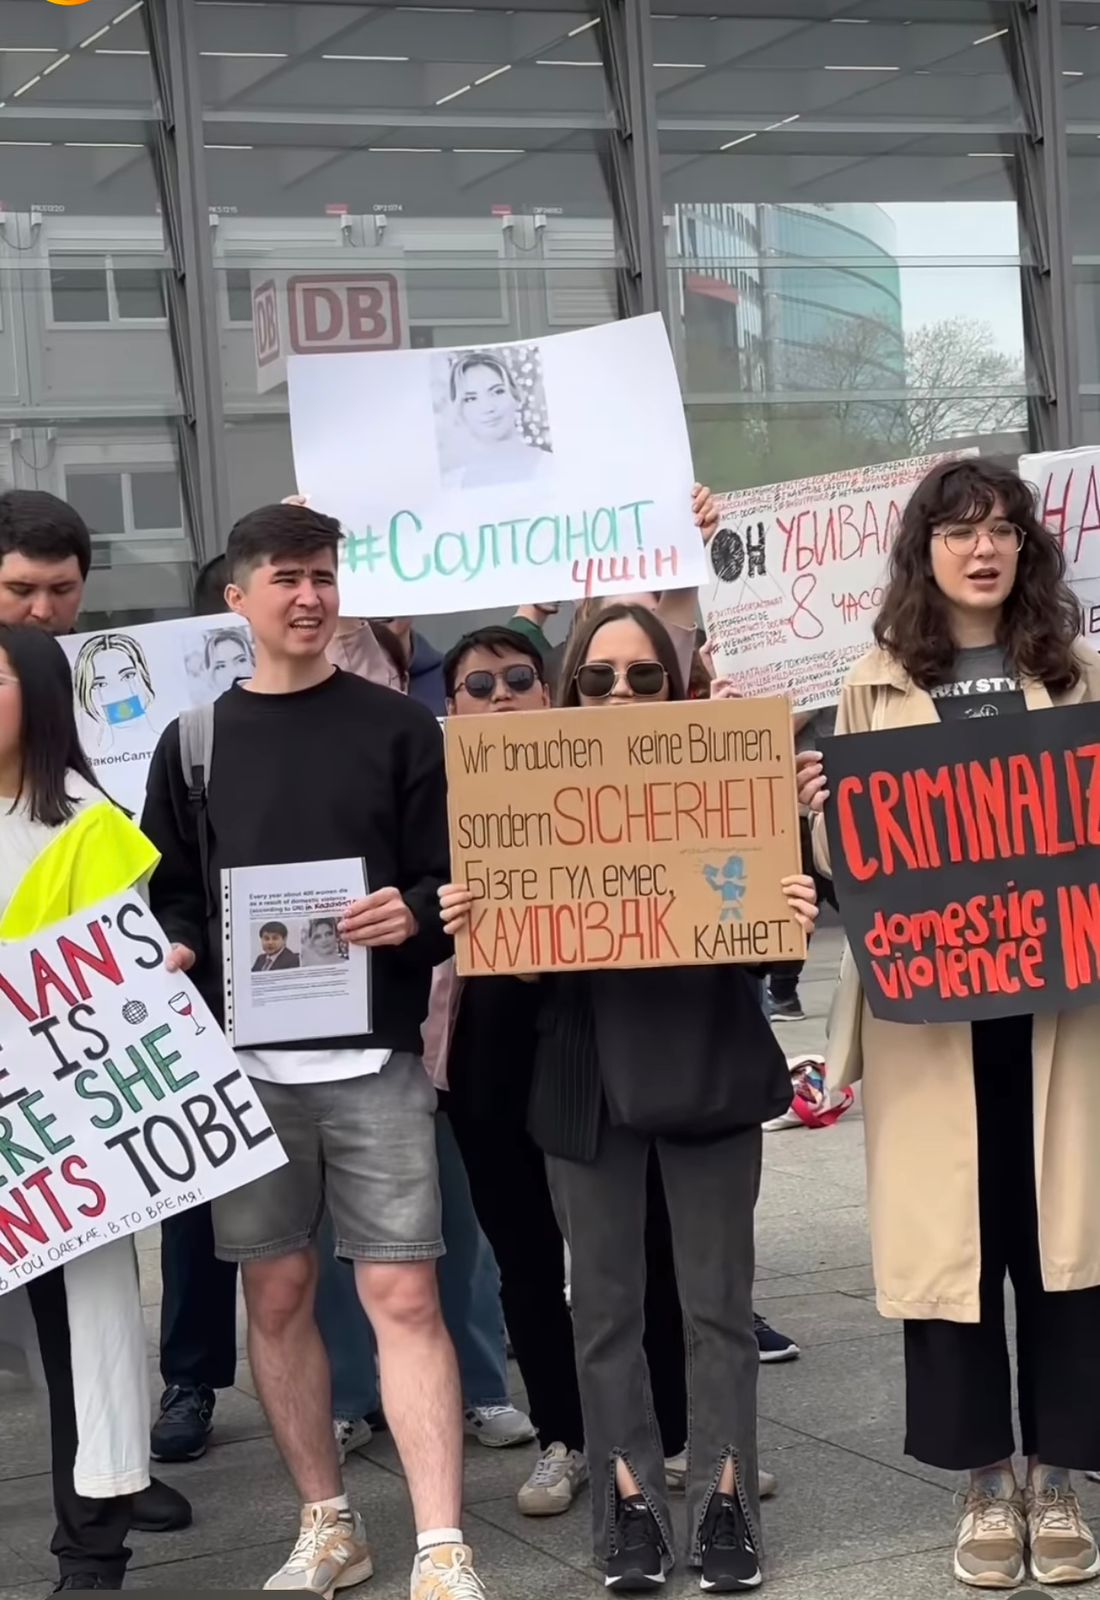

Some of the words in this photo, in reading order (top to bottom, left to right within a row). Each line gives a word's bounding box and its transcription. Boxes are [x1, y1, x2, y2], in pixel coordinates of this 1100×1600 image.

[257, 294, 276, 354] DB
[302, 286, 387, 341] DB
[341, 499, 655, 583] #Салтанат
[711, 522, 767, 583] ОН
[791, 573, 824, 640] 8
[458, 731, 496, 774] Wir
[503, 729, 603, 771] brauchen
[627, 730, 682, 767] keine
[458, 805, 552, 850] sondern
[553, 776, 785, 845] SICHERHEIT.
[864, 881, 1046, 956] domestic
[872, 938, 1045, 999] violence
[29, 1003, 110, 1081] IS
[75, 1023, 200, 1129] SHE
